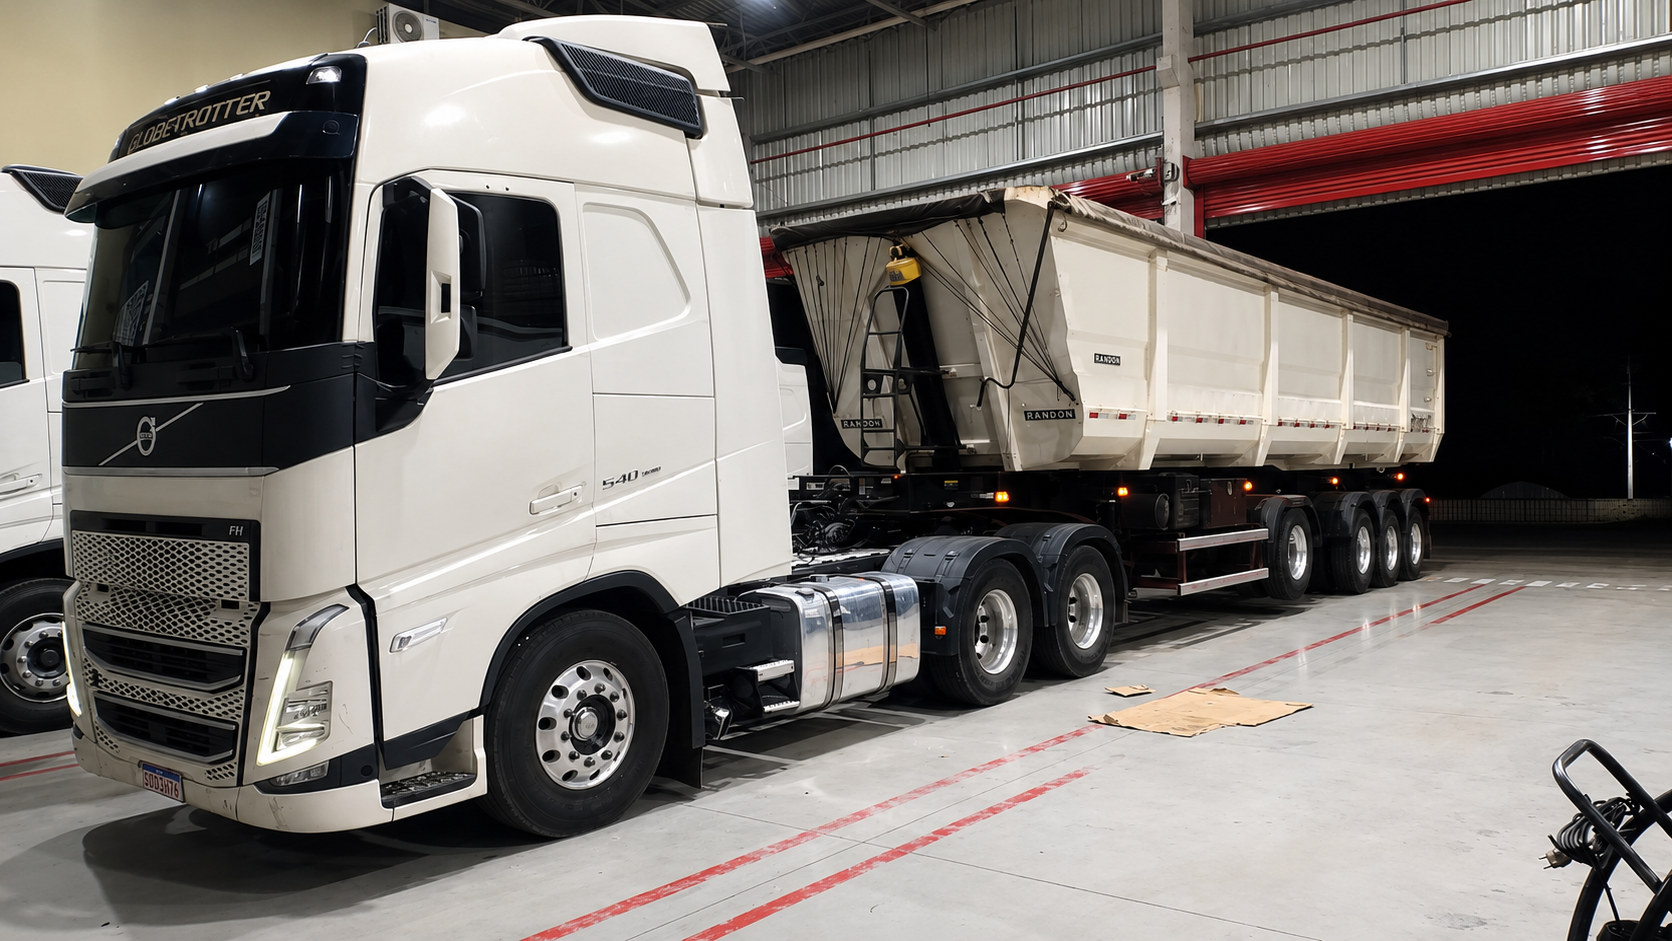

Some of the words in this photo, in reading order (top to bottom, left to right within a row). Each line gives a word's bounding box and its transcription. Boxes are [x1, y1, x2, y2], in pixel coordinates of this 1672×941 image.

[127, 90, 271, 154] GLOBETROTTER
[1026, 410, 1073, 420] RANDON
[602, 470, 638, 490] 540
[229, 525, 244, 536] FH
